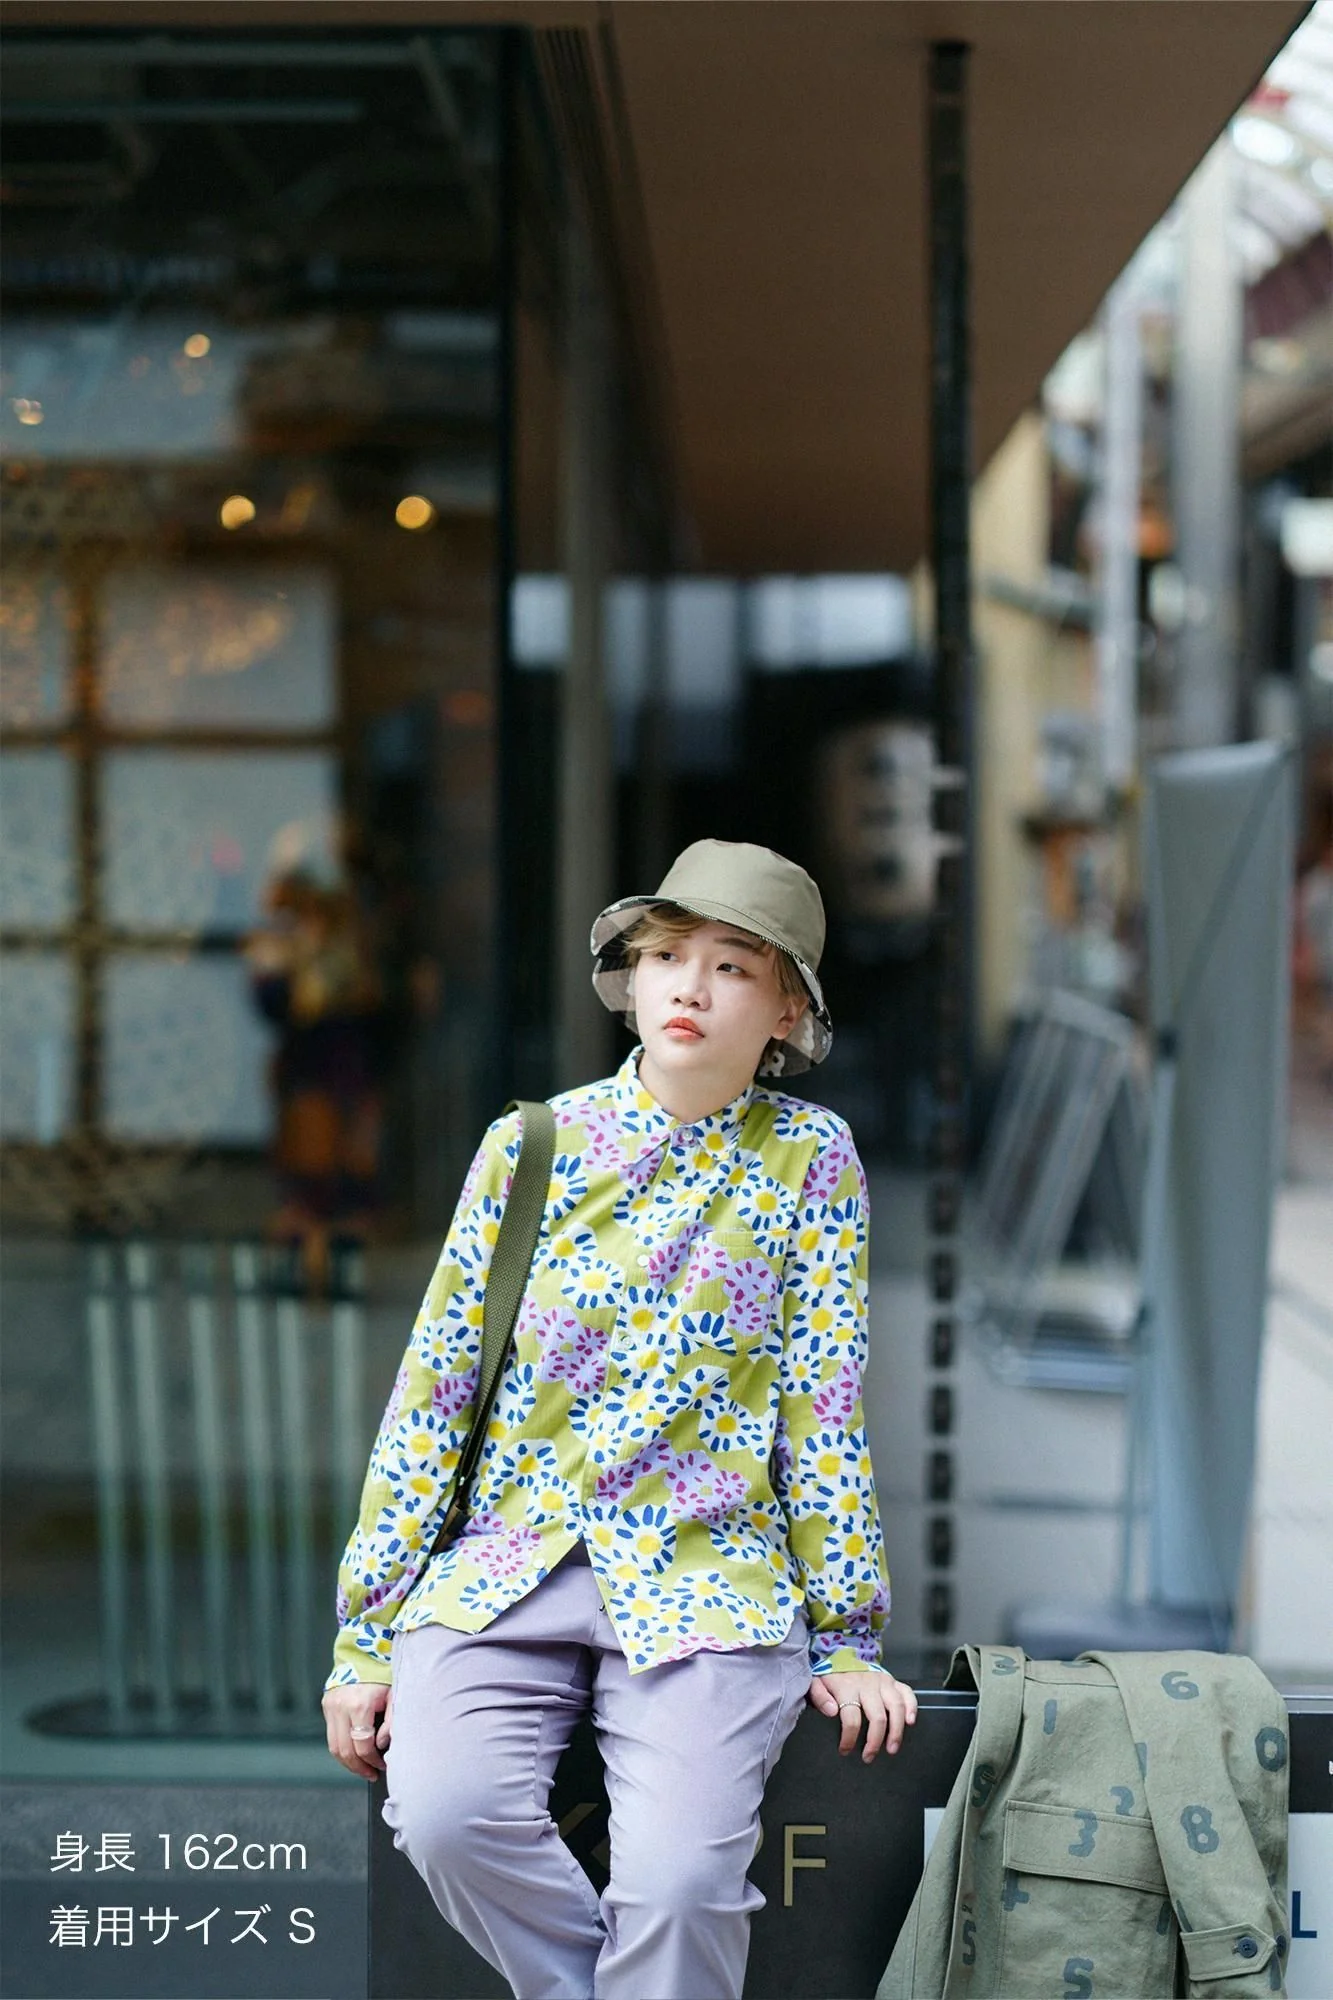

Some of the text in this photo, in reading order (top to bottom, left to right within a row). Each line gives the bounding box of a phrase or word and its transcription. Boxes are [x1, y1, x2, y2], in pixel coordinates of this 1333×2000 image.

[1161, 1671, 1200, 1700] 6
[1068, 1809, 1098, 1857] 3
[1180, 1805, 1219, 1854] 8
